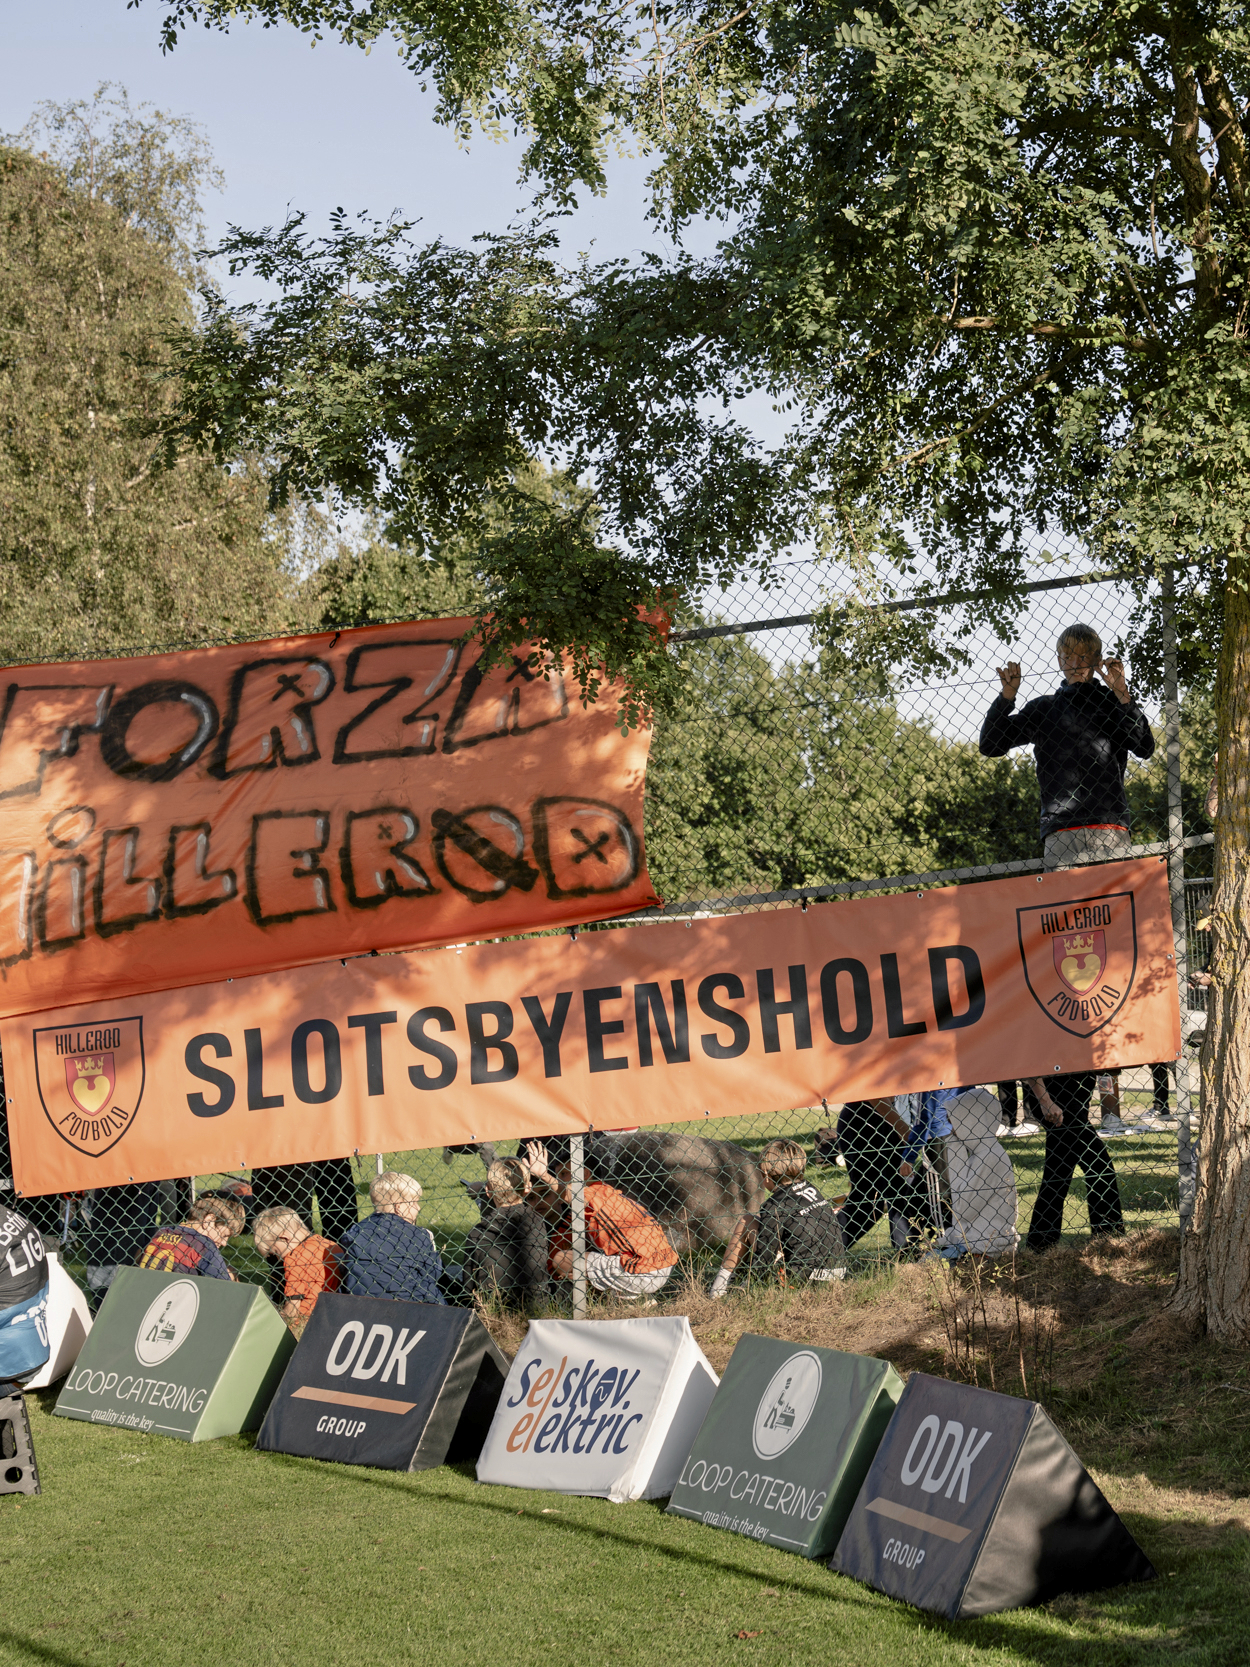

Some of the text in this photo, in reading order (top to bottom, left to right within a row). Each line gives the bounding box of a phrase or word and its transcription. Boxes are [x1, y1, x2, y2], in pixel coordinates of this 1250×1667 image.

[1047, 984, 1121, 1021] FODBOLD
[184, 944, 987, 1118] SLOTSBYENSHOLD
[58, 1105, 129, 1141] FODBOLD
[326, 1320, 427, 1386] ODK
[65, 1366, 207, 1413] LOOP CATERING
[91, 1408, 155, 1432] quality is the key
[316, 1415, 367, 1438] GROUP
[900, 1414, 993, 1504] ODK
[678, 1455, 827, 1522] LOOP CATERING
[703, 1510, 770, 1542] quality is the key
[882, 1538, 926, 1570] GROUP
